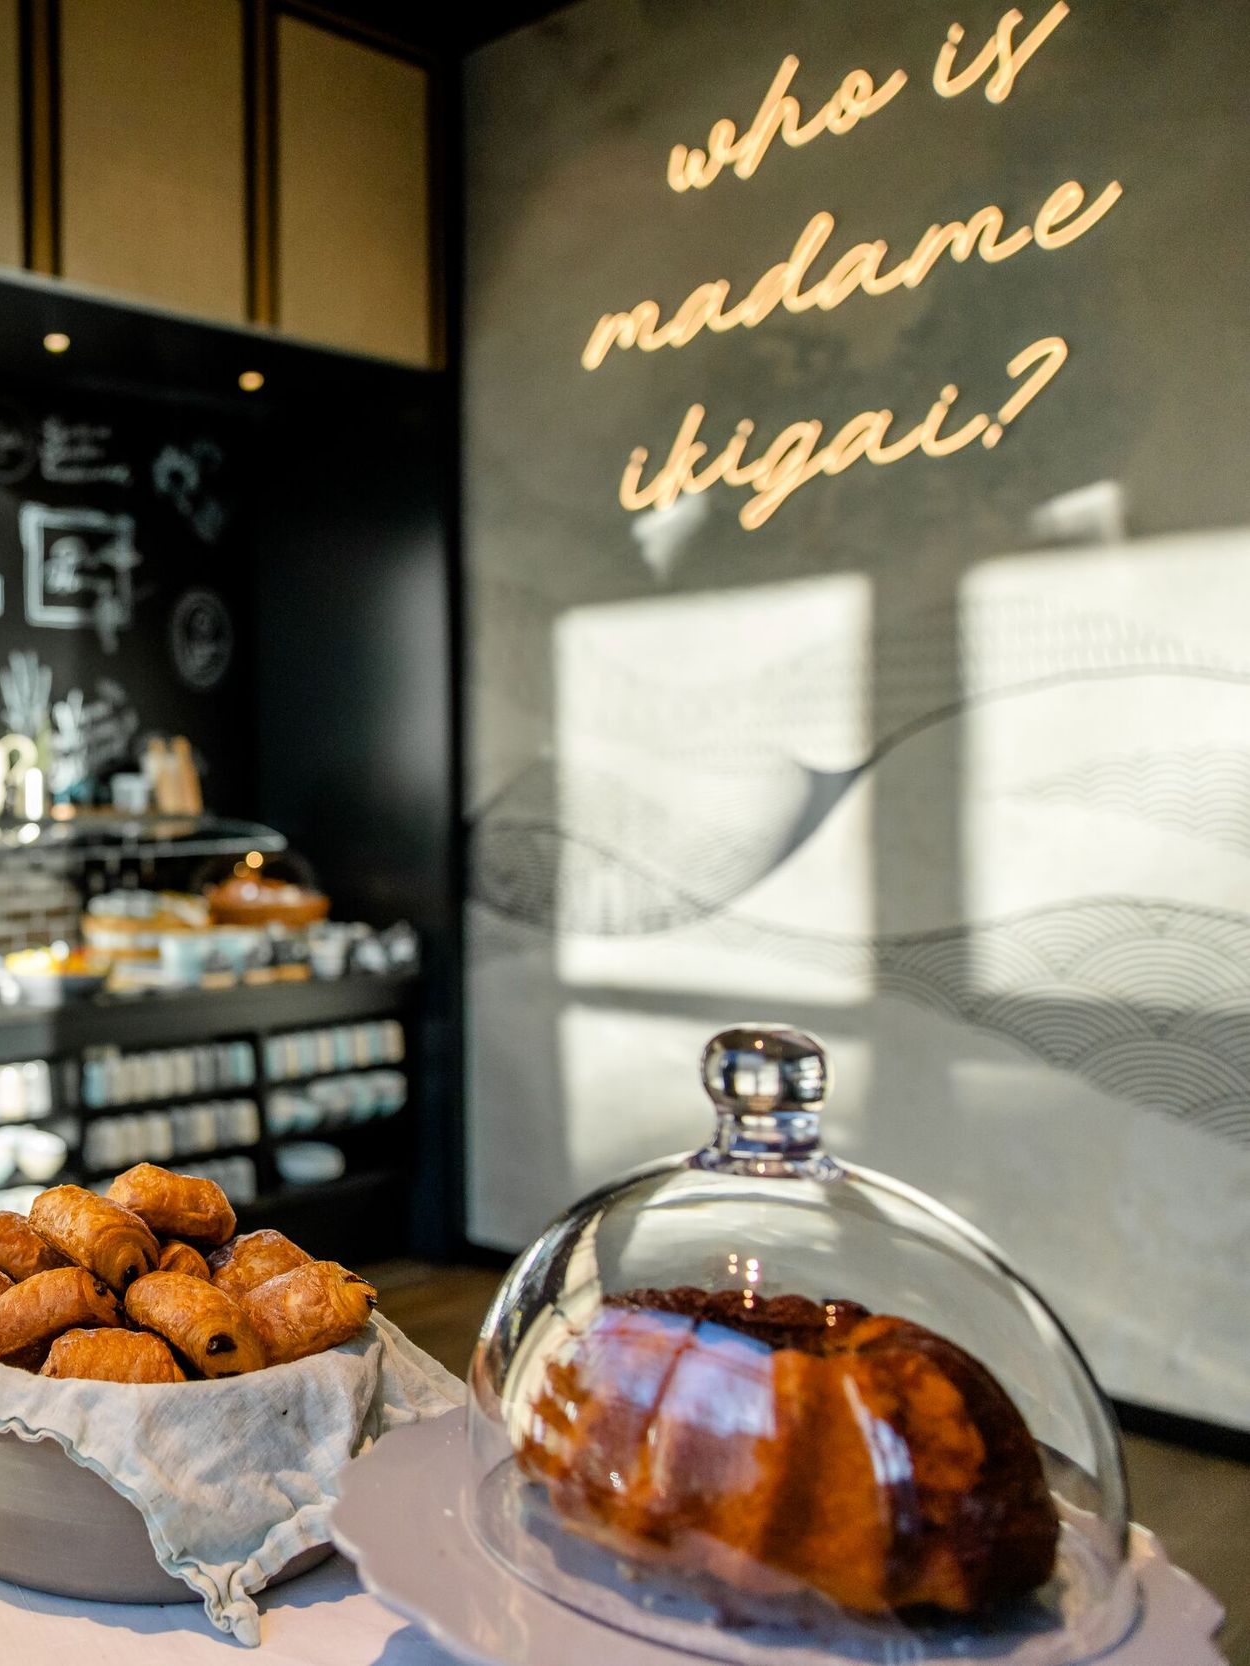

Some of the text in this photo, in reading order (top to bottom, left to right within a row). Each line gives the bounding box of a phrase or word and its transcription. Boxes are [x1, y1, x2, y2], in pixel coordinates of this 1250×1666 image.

[667, 1, 1071, 193] who is
[582, 180, 1123, 371] madame
[619, 336, 1068, 531] ikigai?
